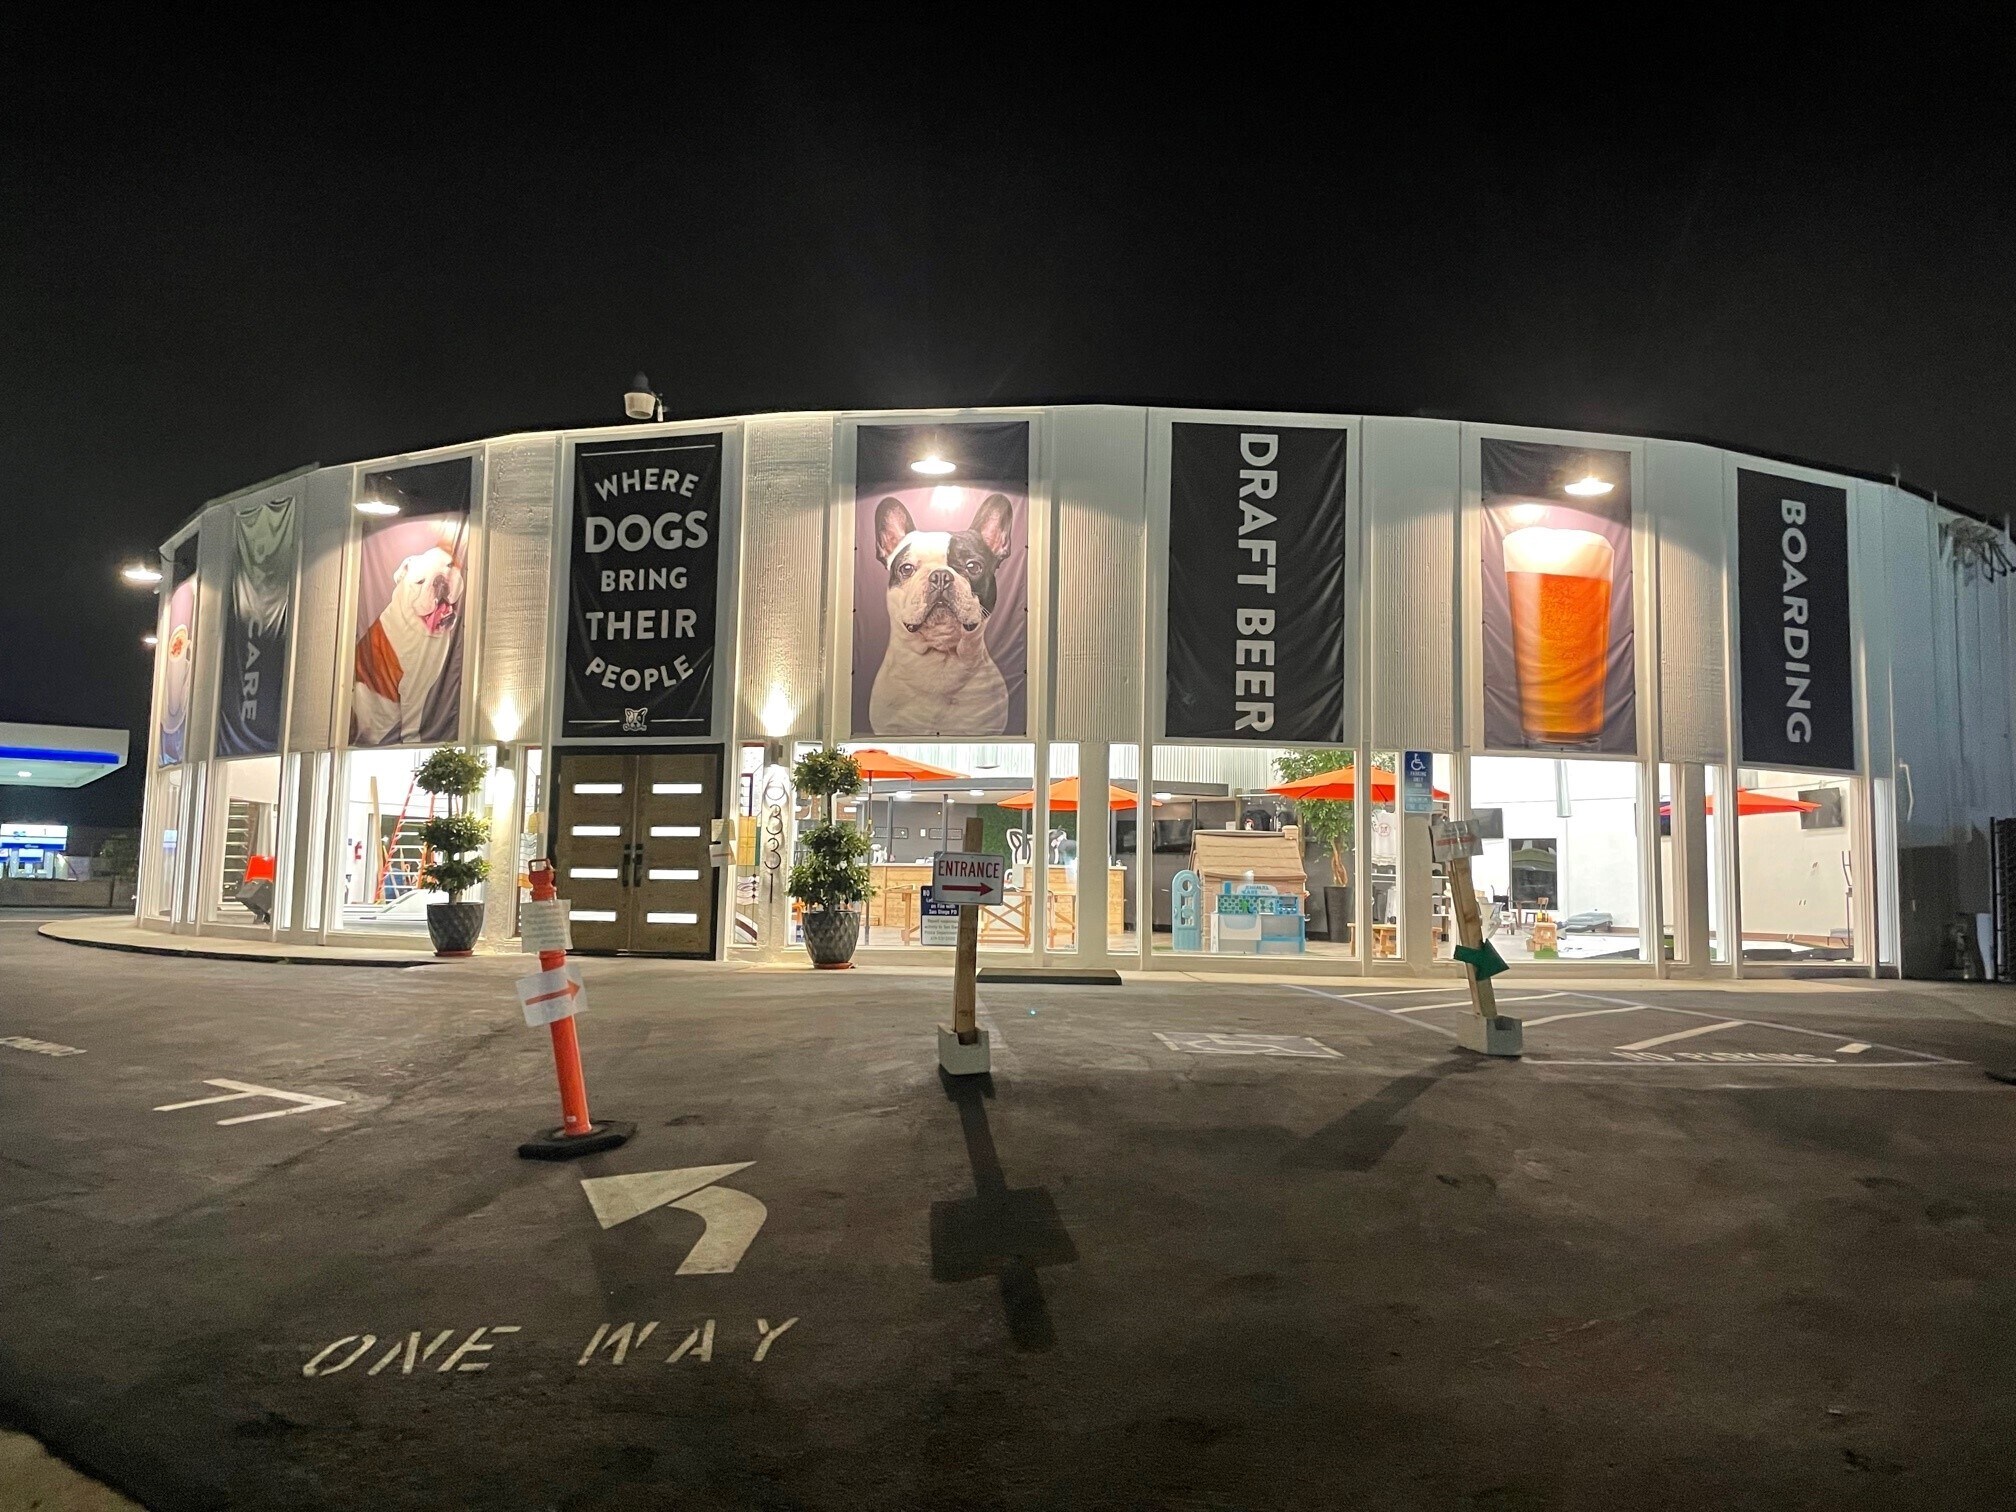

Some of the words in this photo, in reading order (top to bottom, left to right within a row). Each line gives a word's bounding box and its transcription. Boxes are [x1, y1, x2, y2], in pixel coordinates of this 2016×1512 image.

[594, 468, 699, 501] WHERE
[585, 510, 708, 553] DOGS
[1237, 433, 1279, 593] DRAFT
[601, 567, 688, 592] BRING
[585, 608, 697, 641] THEIR
[1781, 499, 1812, 743] BOARDING
[585, 654, 694, 692] PEOPLE
[1235, 608, 1276, 732] BEER
[939, 860, 1000, 878] ENTRANCE
[1609, 1051, 1676, 1062] NO
[1673, 1051, 1837, 1063] PARKING
[303, 1326, 522, 1377] ONE
[577, 1317, 799, 1366] WAY
